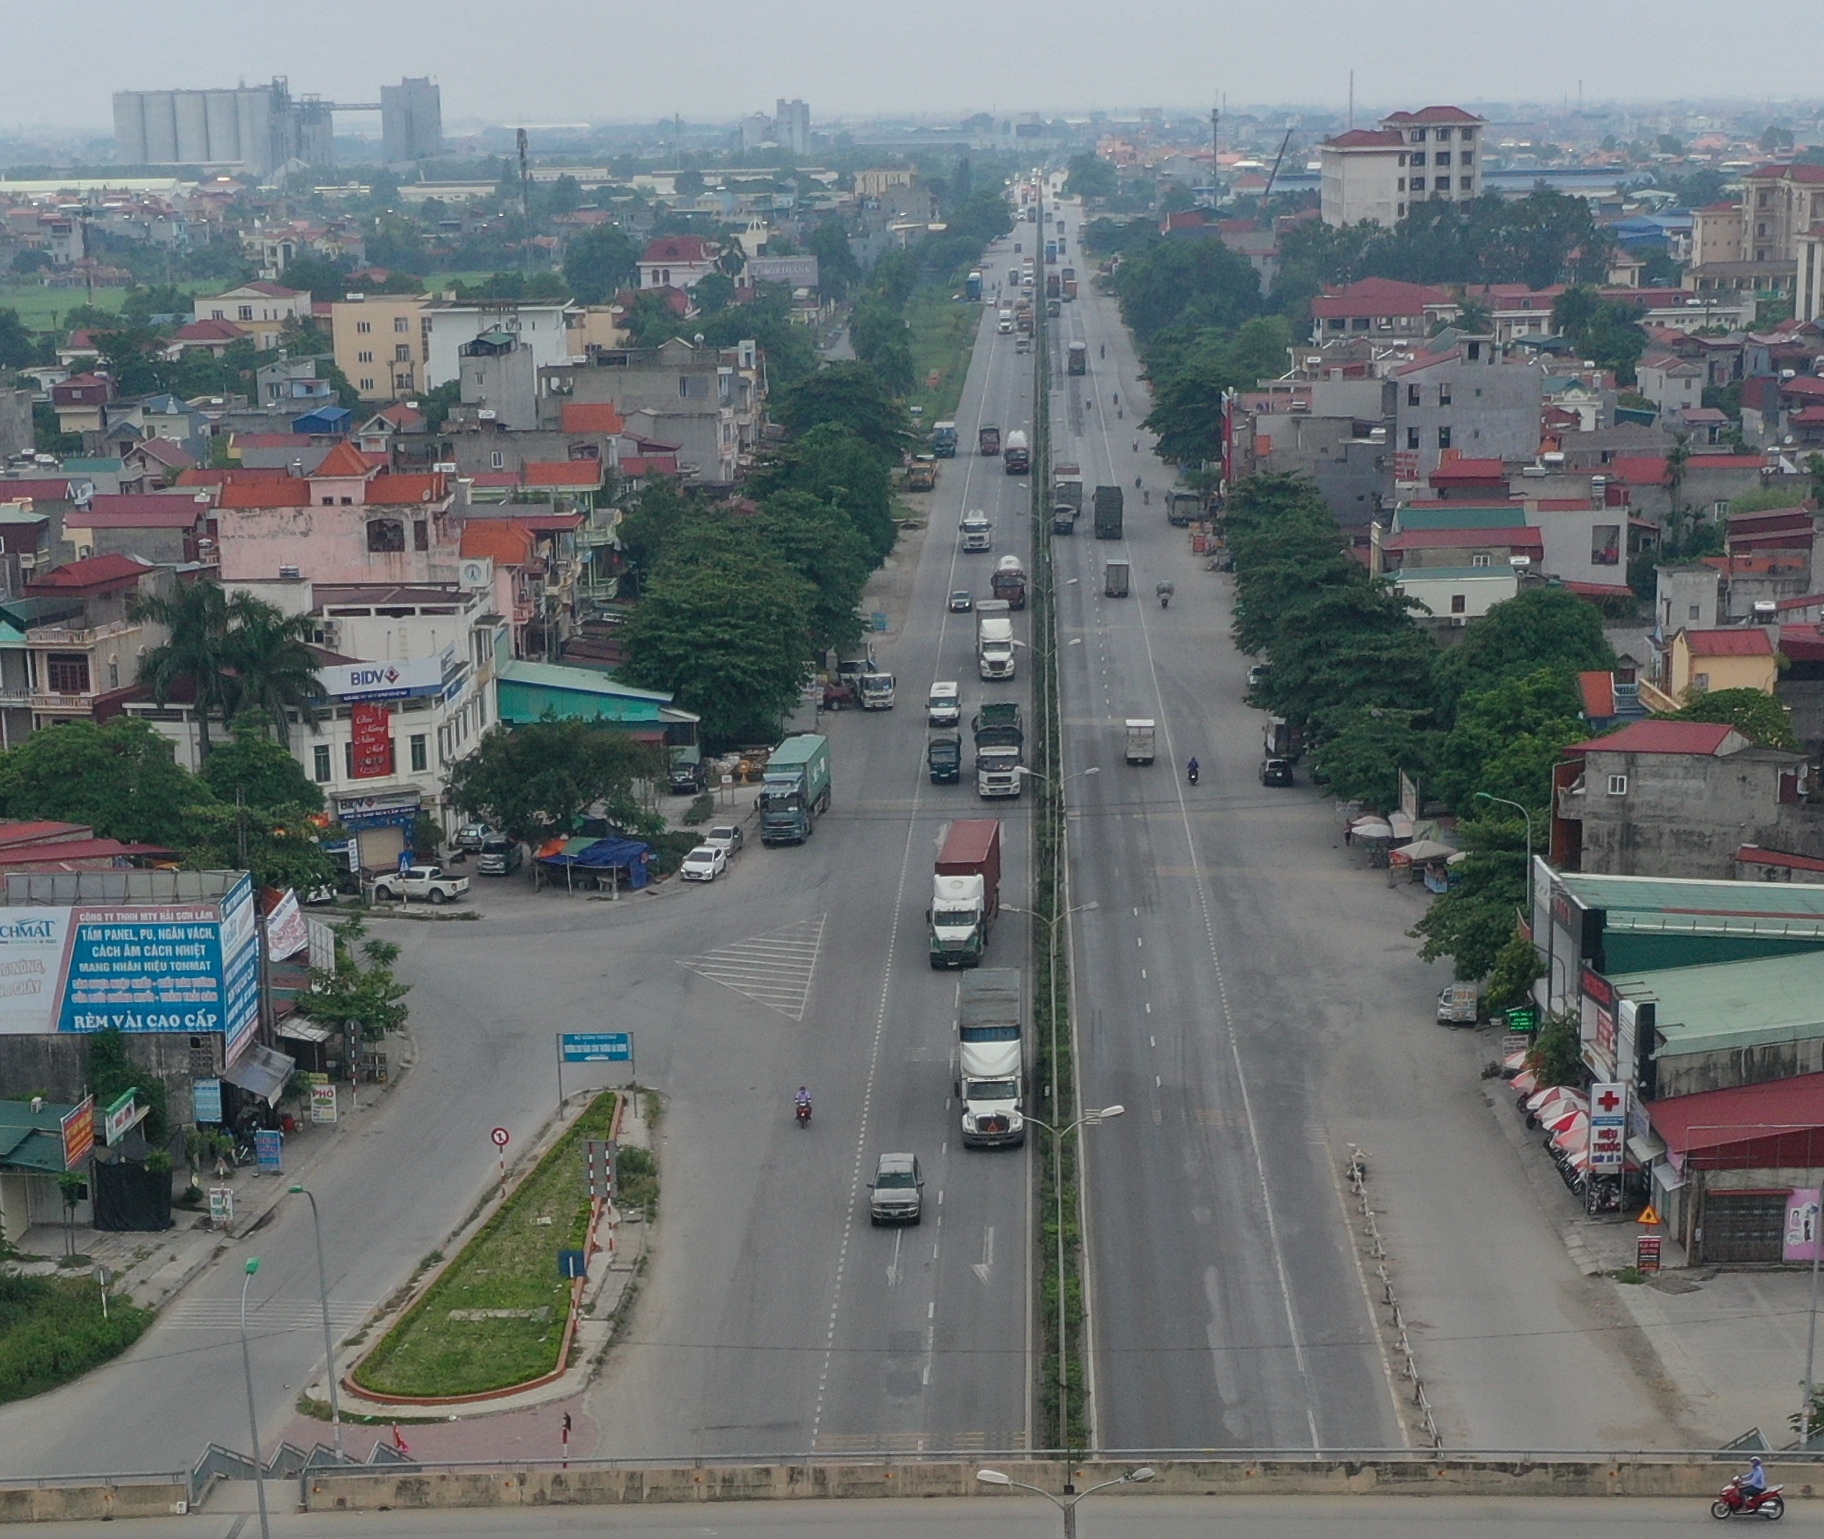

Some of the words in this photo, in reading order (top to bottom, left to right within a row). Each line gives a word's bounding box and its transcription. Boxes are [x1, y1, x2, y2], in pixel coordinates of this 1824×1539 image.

[351, 670, 384, 686] BIDV
[92, 943, 121, 957] CÁCH
[143, 943, 172, 956] CÁCH
[175, 942, 205, 958] NHIỆT
[112, 1010, 142, 1028] VẢI
[146, 1014, 180, 1027] CAO
[184, 1008, 217, 1027] CẤP
